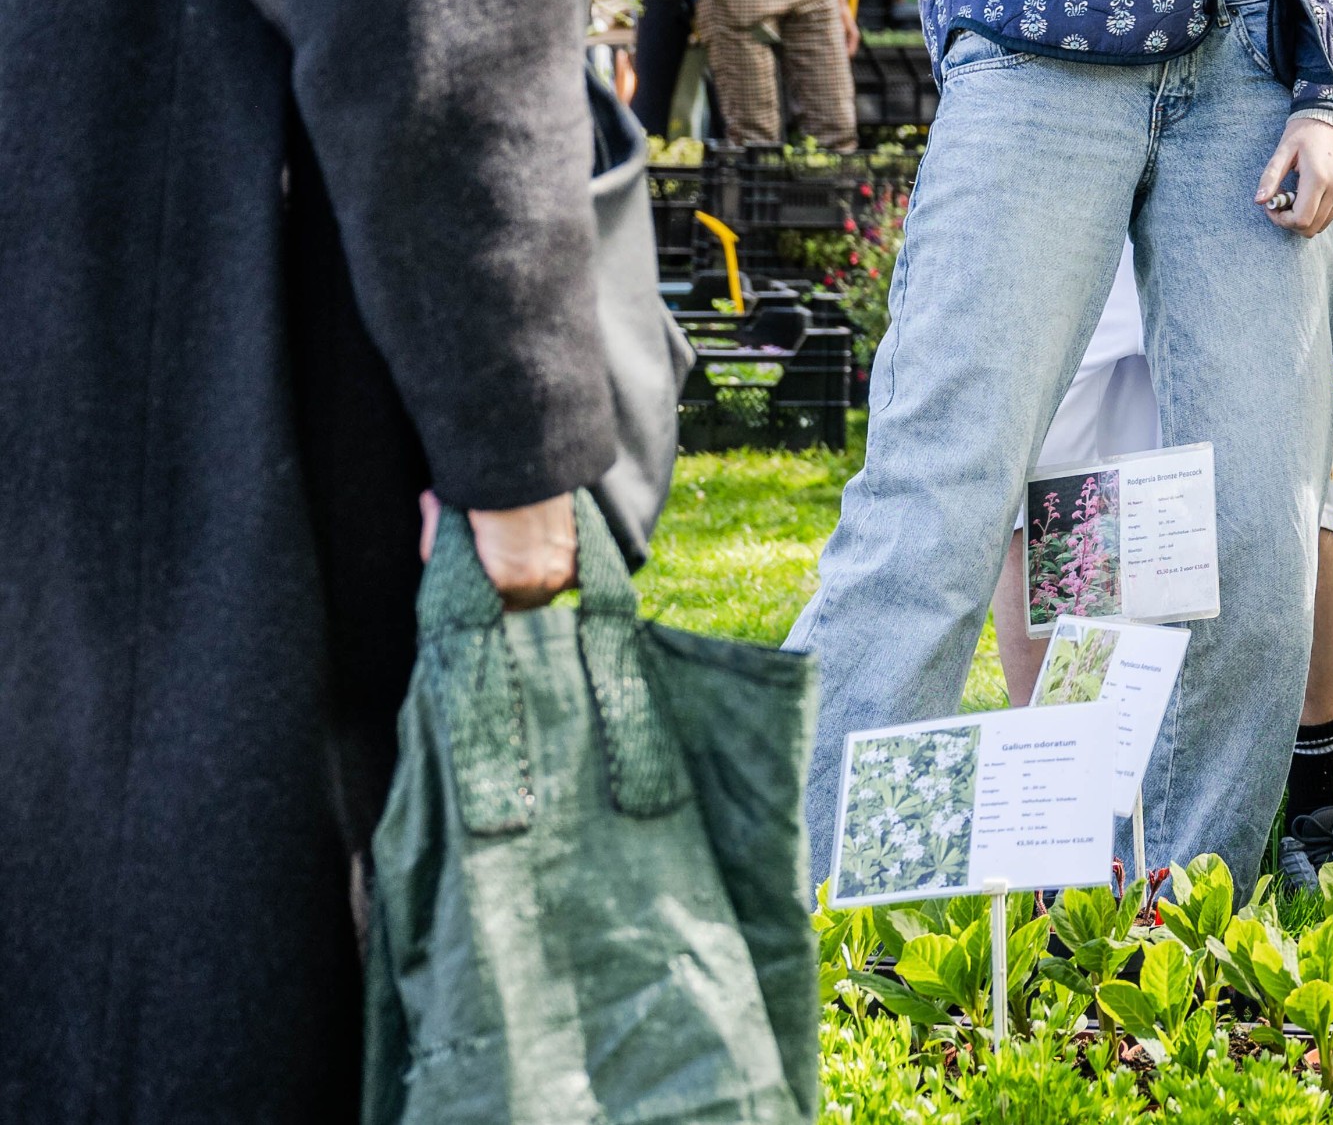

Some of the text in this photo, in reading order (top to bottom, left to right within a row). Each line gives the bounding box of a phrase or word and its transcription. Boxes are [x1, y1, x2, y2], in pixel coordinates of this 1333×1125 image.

[1127, 476, 1156, 486] Rodgersia
[1178, 468, 1203, 478] Peacock
[1002, 739, 1077, 751] Galium odoratum
